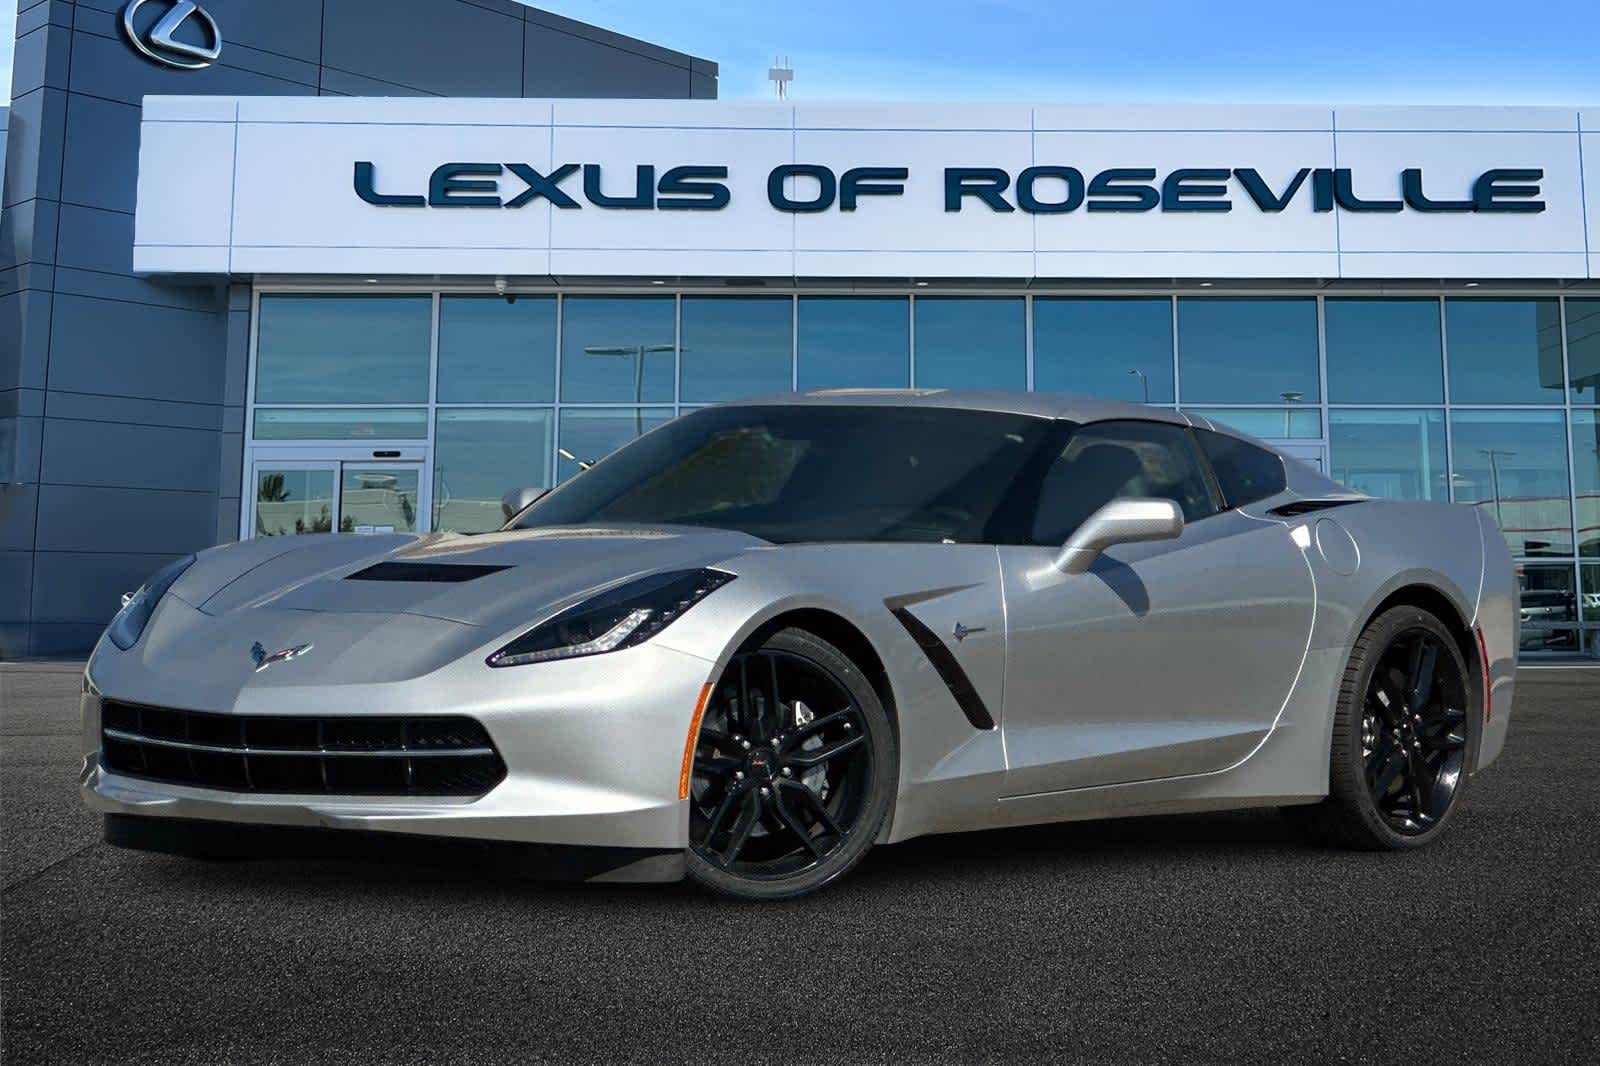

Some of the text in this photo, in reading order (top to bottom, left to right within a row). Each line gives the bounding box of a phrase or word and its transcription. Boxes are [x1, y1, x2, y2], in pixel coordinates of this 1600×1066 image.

[353, 160, 1546, 214] LEXUS OF ROSEVILLE
